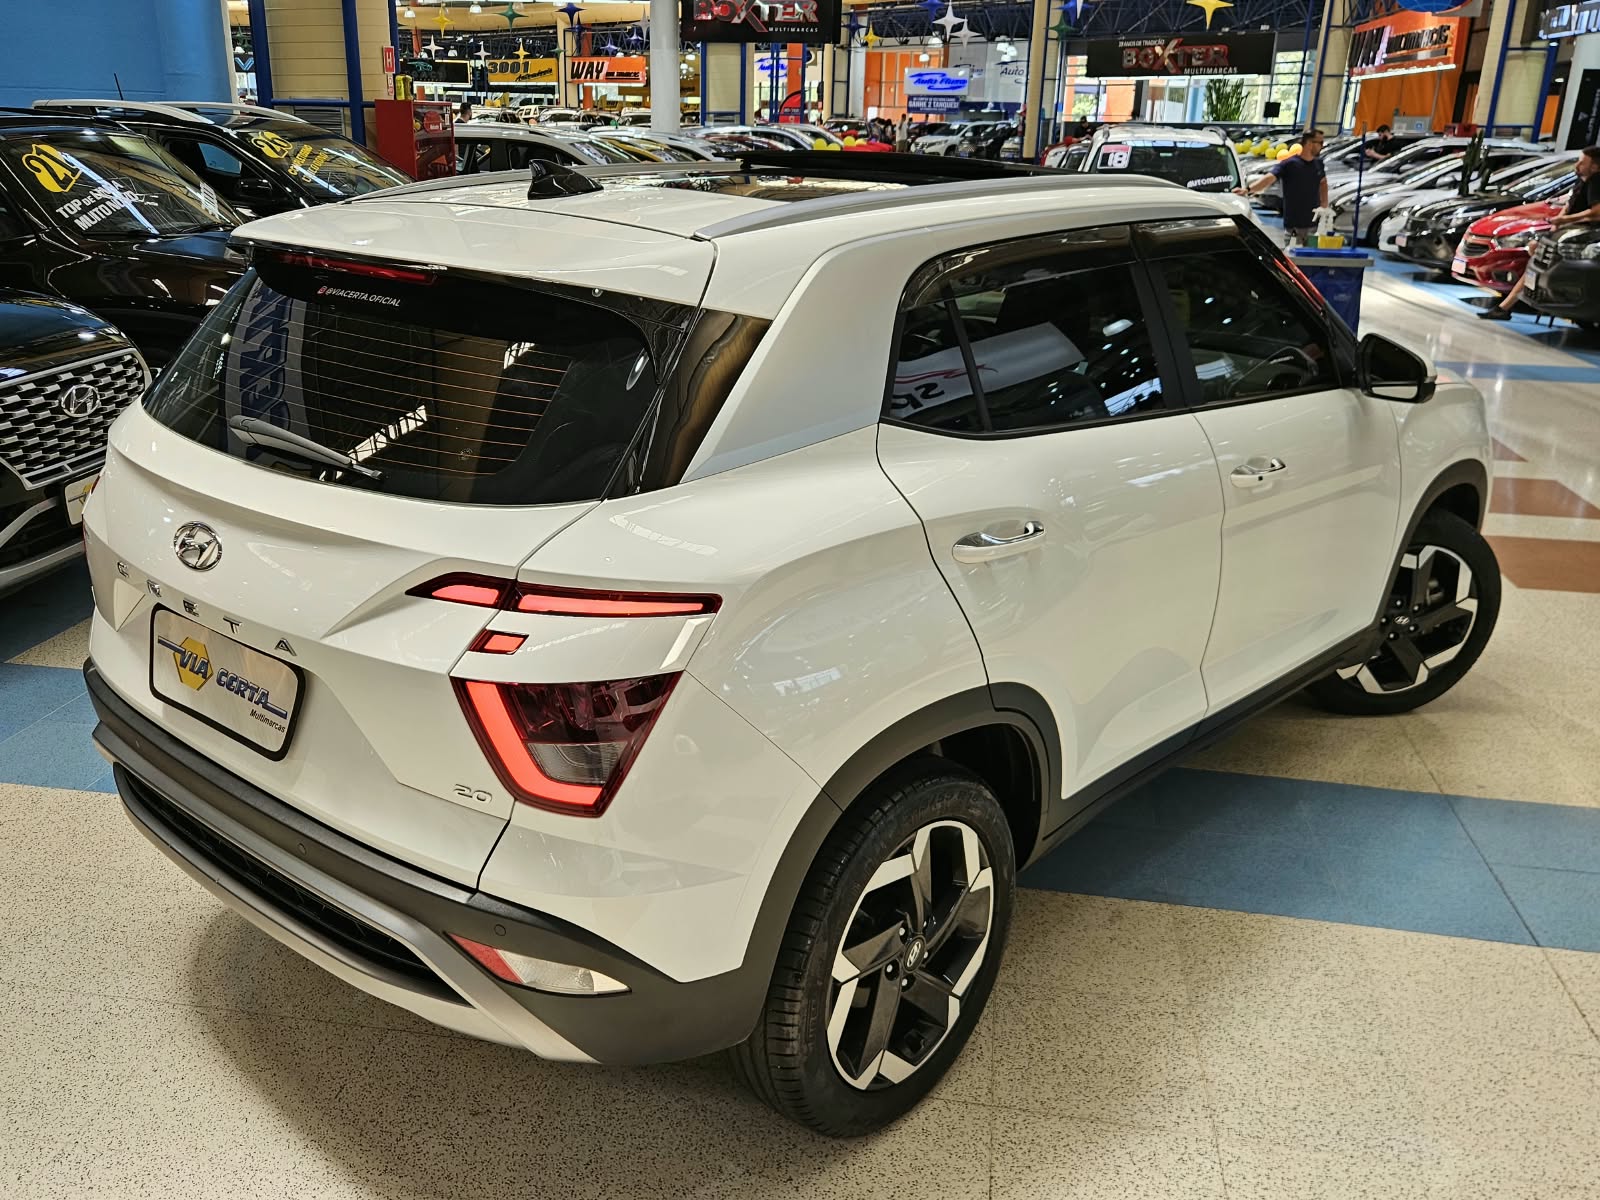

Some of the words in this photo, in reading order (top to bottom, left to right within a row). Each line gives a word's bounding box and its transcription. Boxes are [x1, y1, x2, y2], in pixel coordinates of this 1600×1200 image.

[693, 0, 819, 32] BOXTER
[1121, 38, 1229, 74] BOXTER
[488, 61, 530, 74] 3001
[570, 61, 605, 80] WAY
[1000, 65, 1025, 76] Auto
[1183, 66, 1238, 75] MULTIMARCAS
[24, 145, 81, 192] 21
[81, 195, 97, 206] DE
[88, 180, 124, 200] LINA
[56, 198, 82, 219] TOP
[74, 202, 113, 231] MUITO
[325, 287, 401, 307] @VIACERTA.OFICIAL
[116, 560, 298, 657] CRETA
[178, 650, 211, 680] VIA
[215, 667, 271, 709] CERTA
[249, 708, 286, 733] Multimarcas
